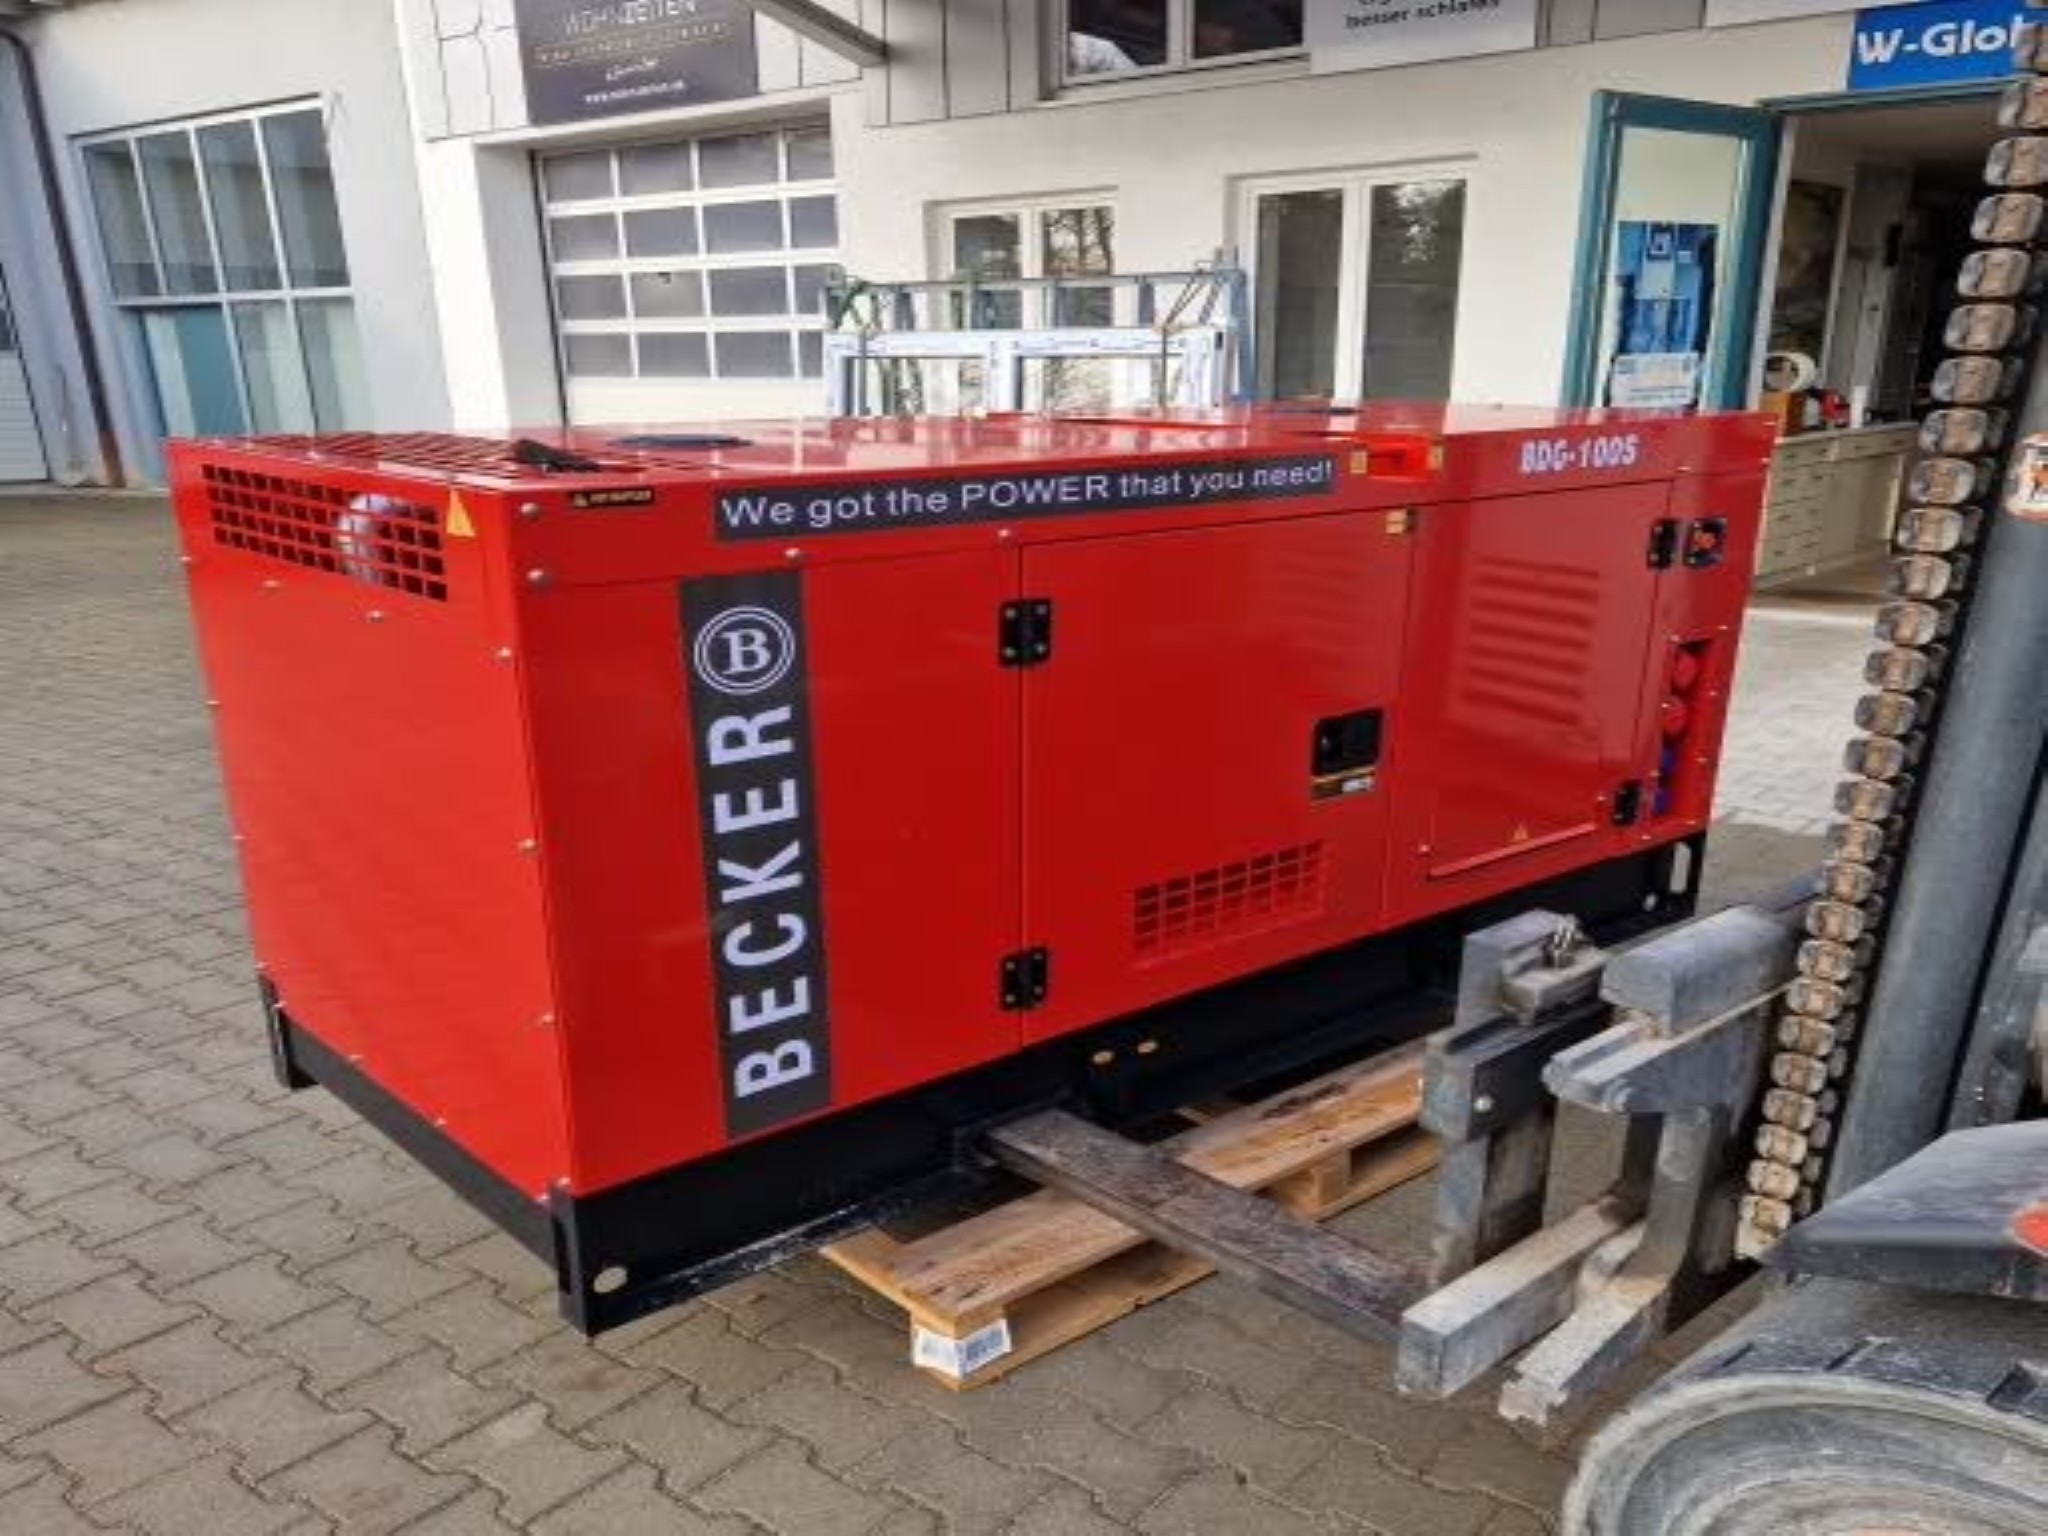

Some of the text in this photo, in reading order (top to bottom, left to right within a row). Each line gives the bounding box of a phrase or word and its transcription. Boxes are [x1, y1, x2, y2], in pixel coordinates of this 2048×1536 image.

[721, 460, 1333, 528] We got the POWER that you need!
[723, 628, 773, 675] B
[706, 704, 814, 1099] BECKER
